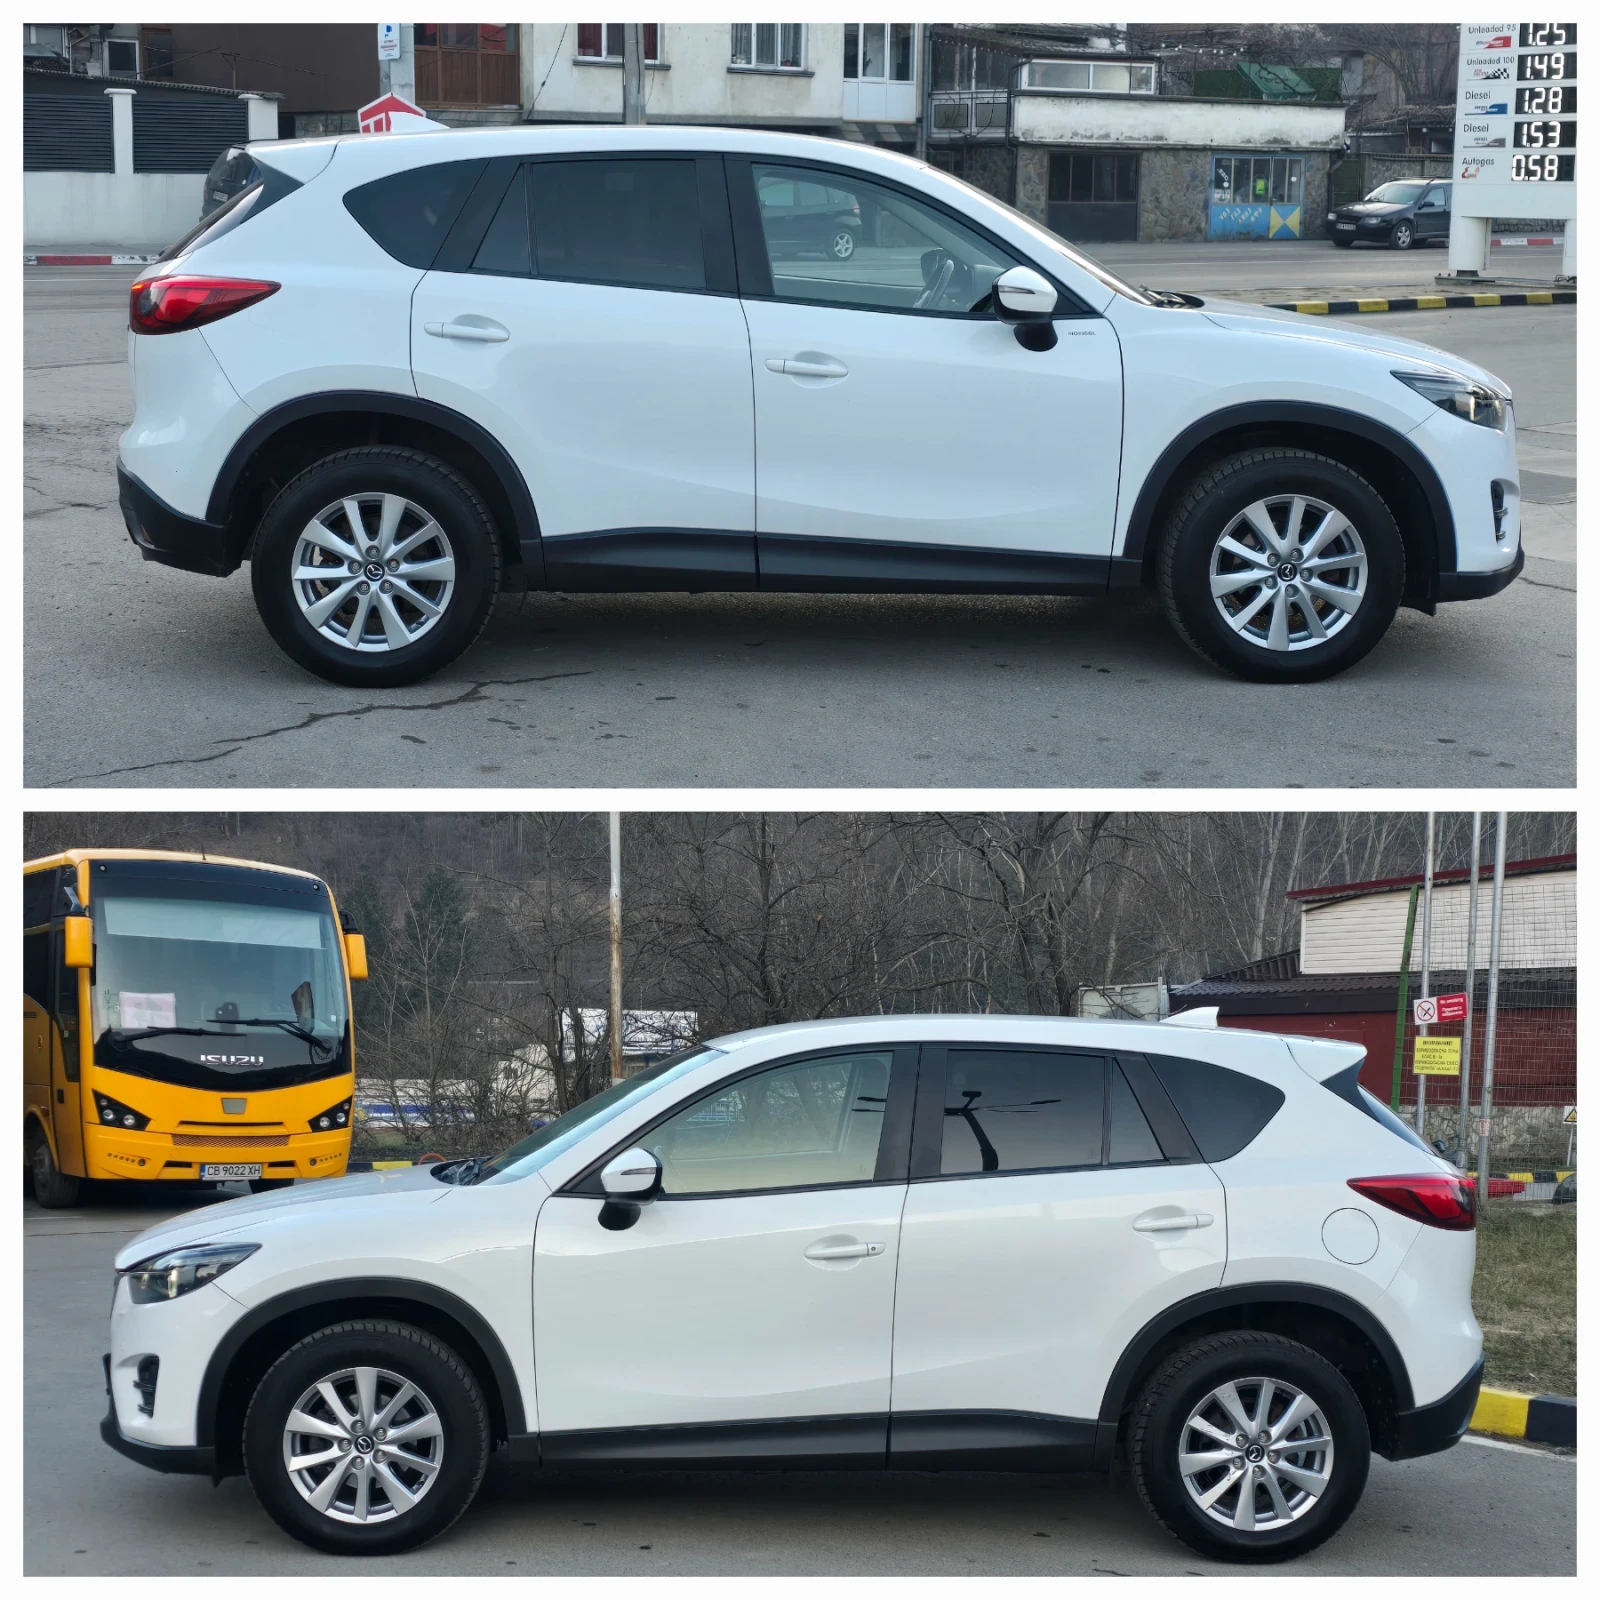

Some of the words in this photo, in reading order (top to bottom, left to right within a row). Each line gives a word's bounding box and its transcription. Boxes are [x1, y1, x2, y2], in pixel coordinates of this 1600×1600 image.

[1468, 24, 1504, 34] Unleaded
[1506, 24, 1517, 32] 95
[1466, 56, 1501, 66] Unleaded
[1503, 56, 1515, 64] 100
[1526, 52, 1565, 80] 1.49
[1465, 90, 1491, 100] Diesel
[1524, 86, 1563, 114] 1.28
[1463, 123, 1489, 133] Diesel
[1522, 120, 1561, 148] 1.53
[1461, 157, 1495, 167] Autogas
[1511, 154, 1559, 181] 0.58
[200, 1054, 264, 1066] ISUZU
[207, 1165, 220, 1176] CB
[222, 1165, 246, 1176] 9022
[248, 1165, 261, 1176] XH
